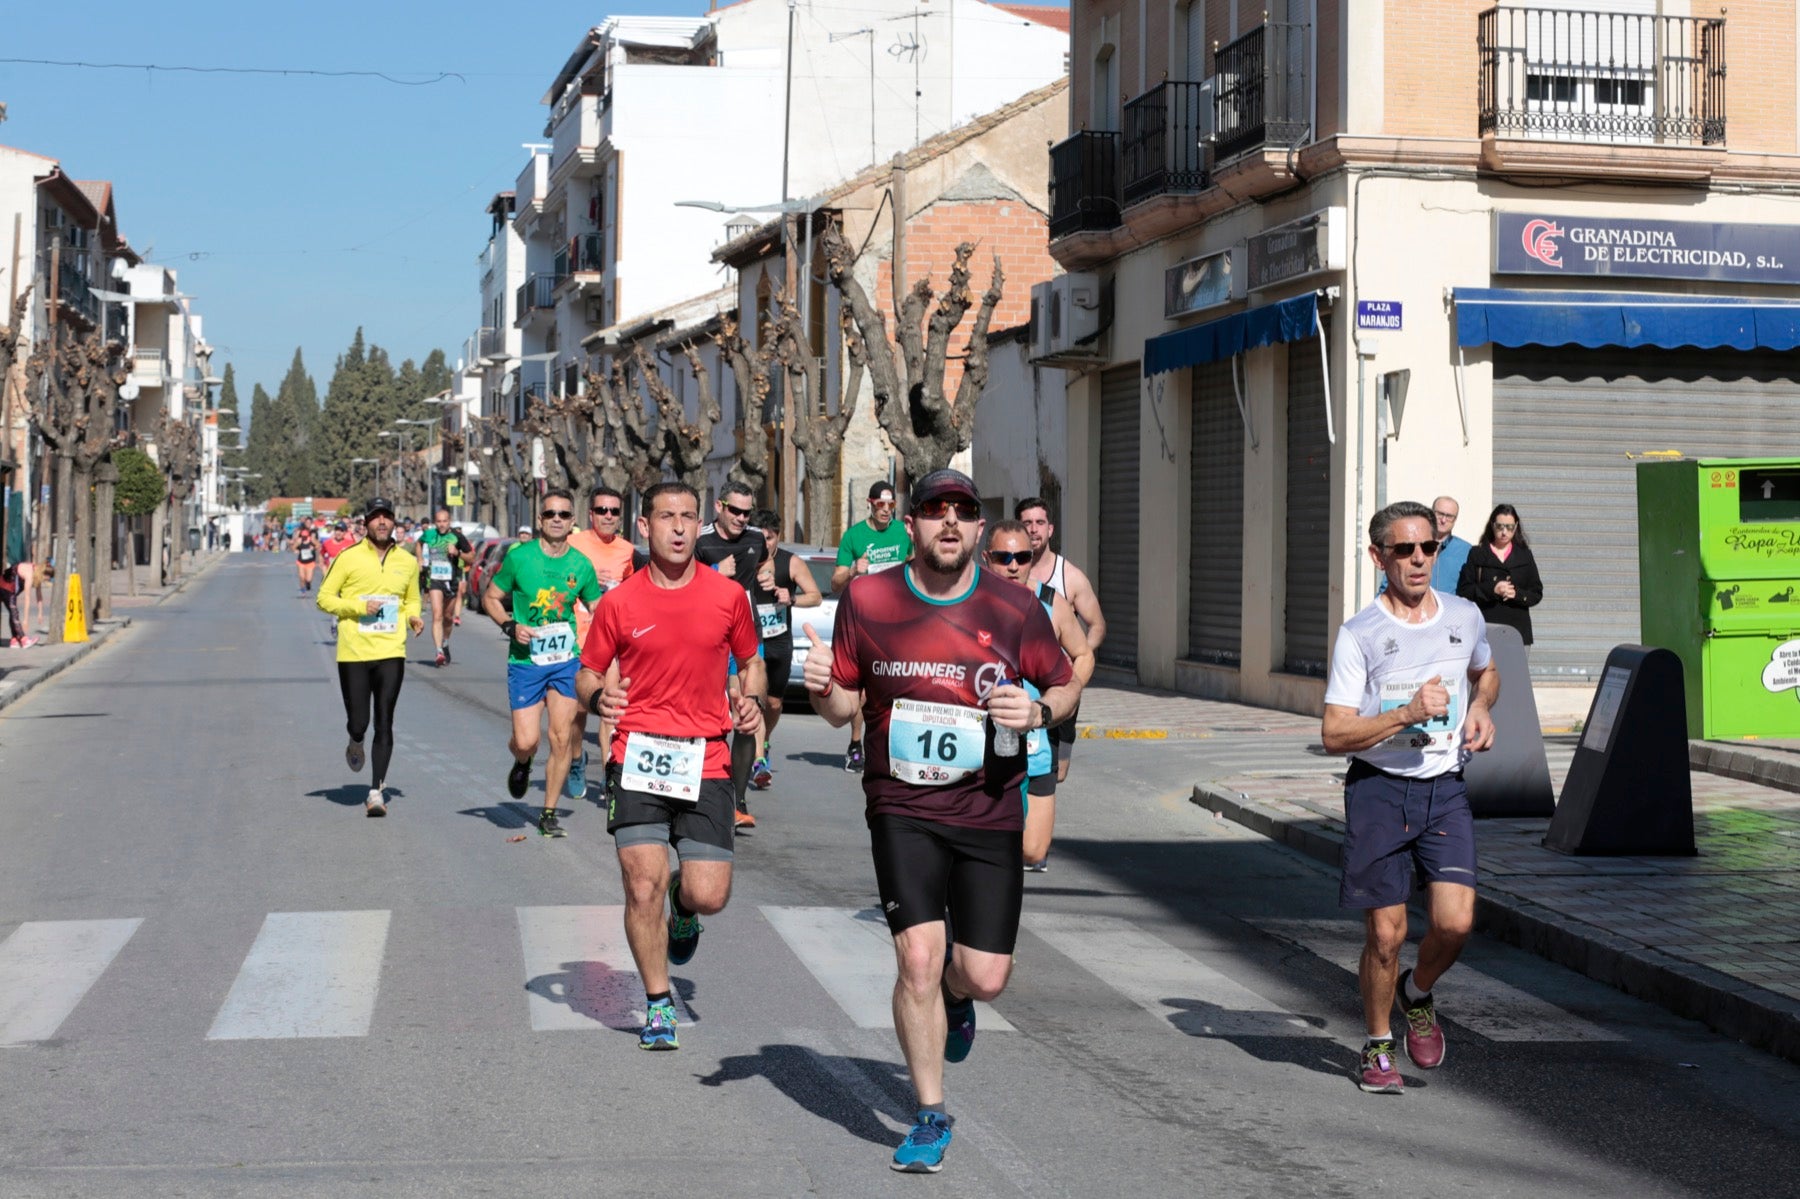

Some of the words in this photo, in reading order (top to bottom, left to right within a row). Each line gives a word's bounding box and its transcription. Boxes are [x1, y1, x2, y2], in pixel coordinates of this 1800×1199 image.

[1570, 227, 1676, 247] GRANADINA
[1584, 246, 1610, 261] DE
[1613, 247, 1750, 268] ELECTRICIDAD,
[1756, 256, 1784, 269] S.L.
[1367, 303, 1391, 312] PLAZA
[1360, 314, 1400, 328] NARANJOS
[1725, 534, 1777, 553] Ropa
[537, 635, 567, 652] 747
[872, 660, 967, 681] GINRUNNERS
[931, 677, 964, 689] GRANADA
[1773, 677, 1797, 685] Ambiente
[915, 704, 931, 714] GRAN
[932, 706, 954, 717] PREMIO
[954, 709, 963, 718] DE
[917, 729, 958, 762] 16
